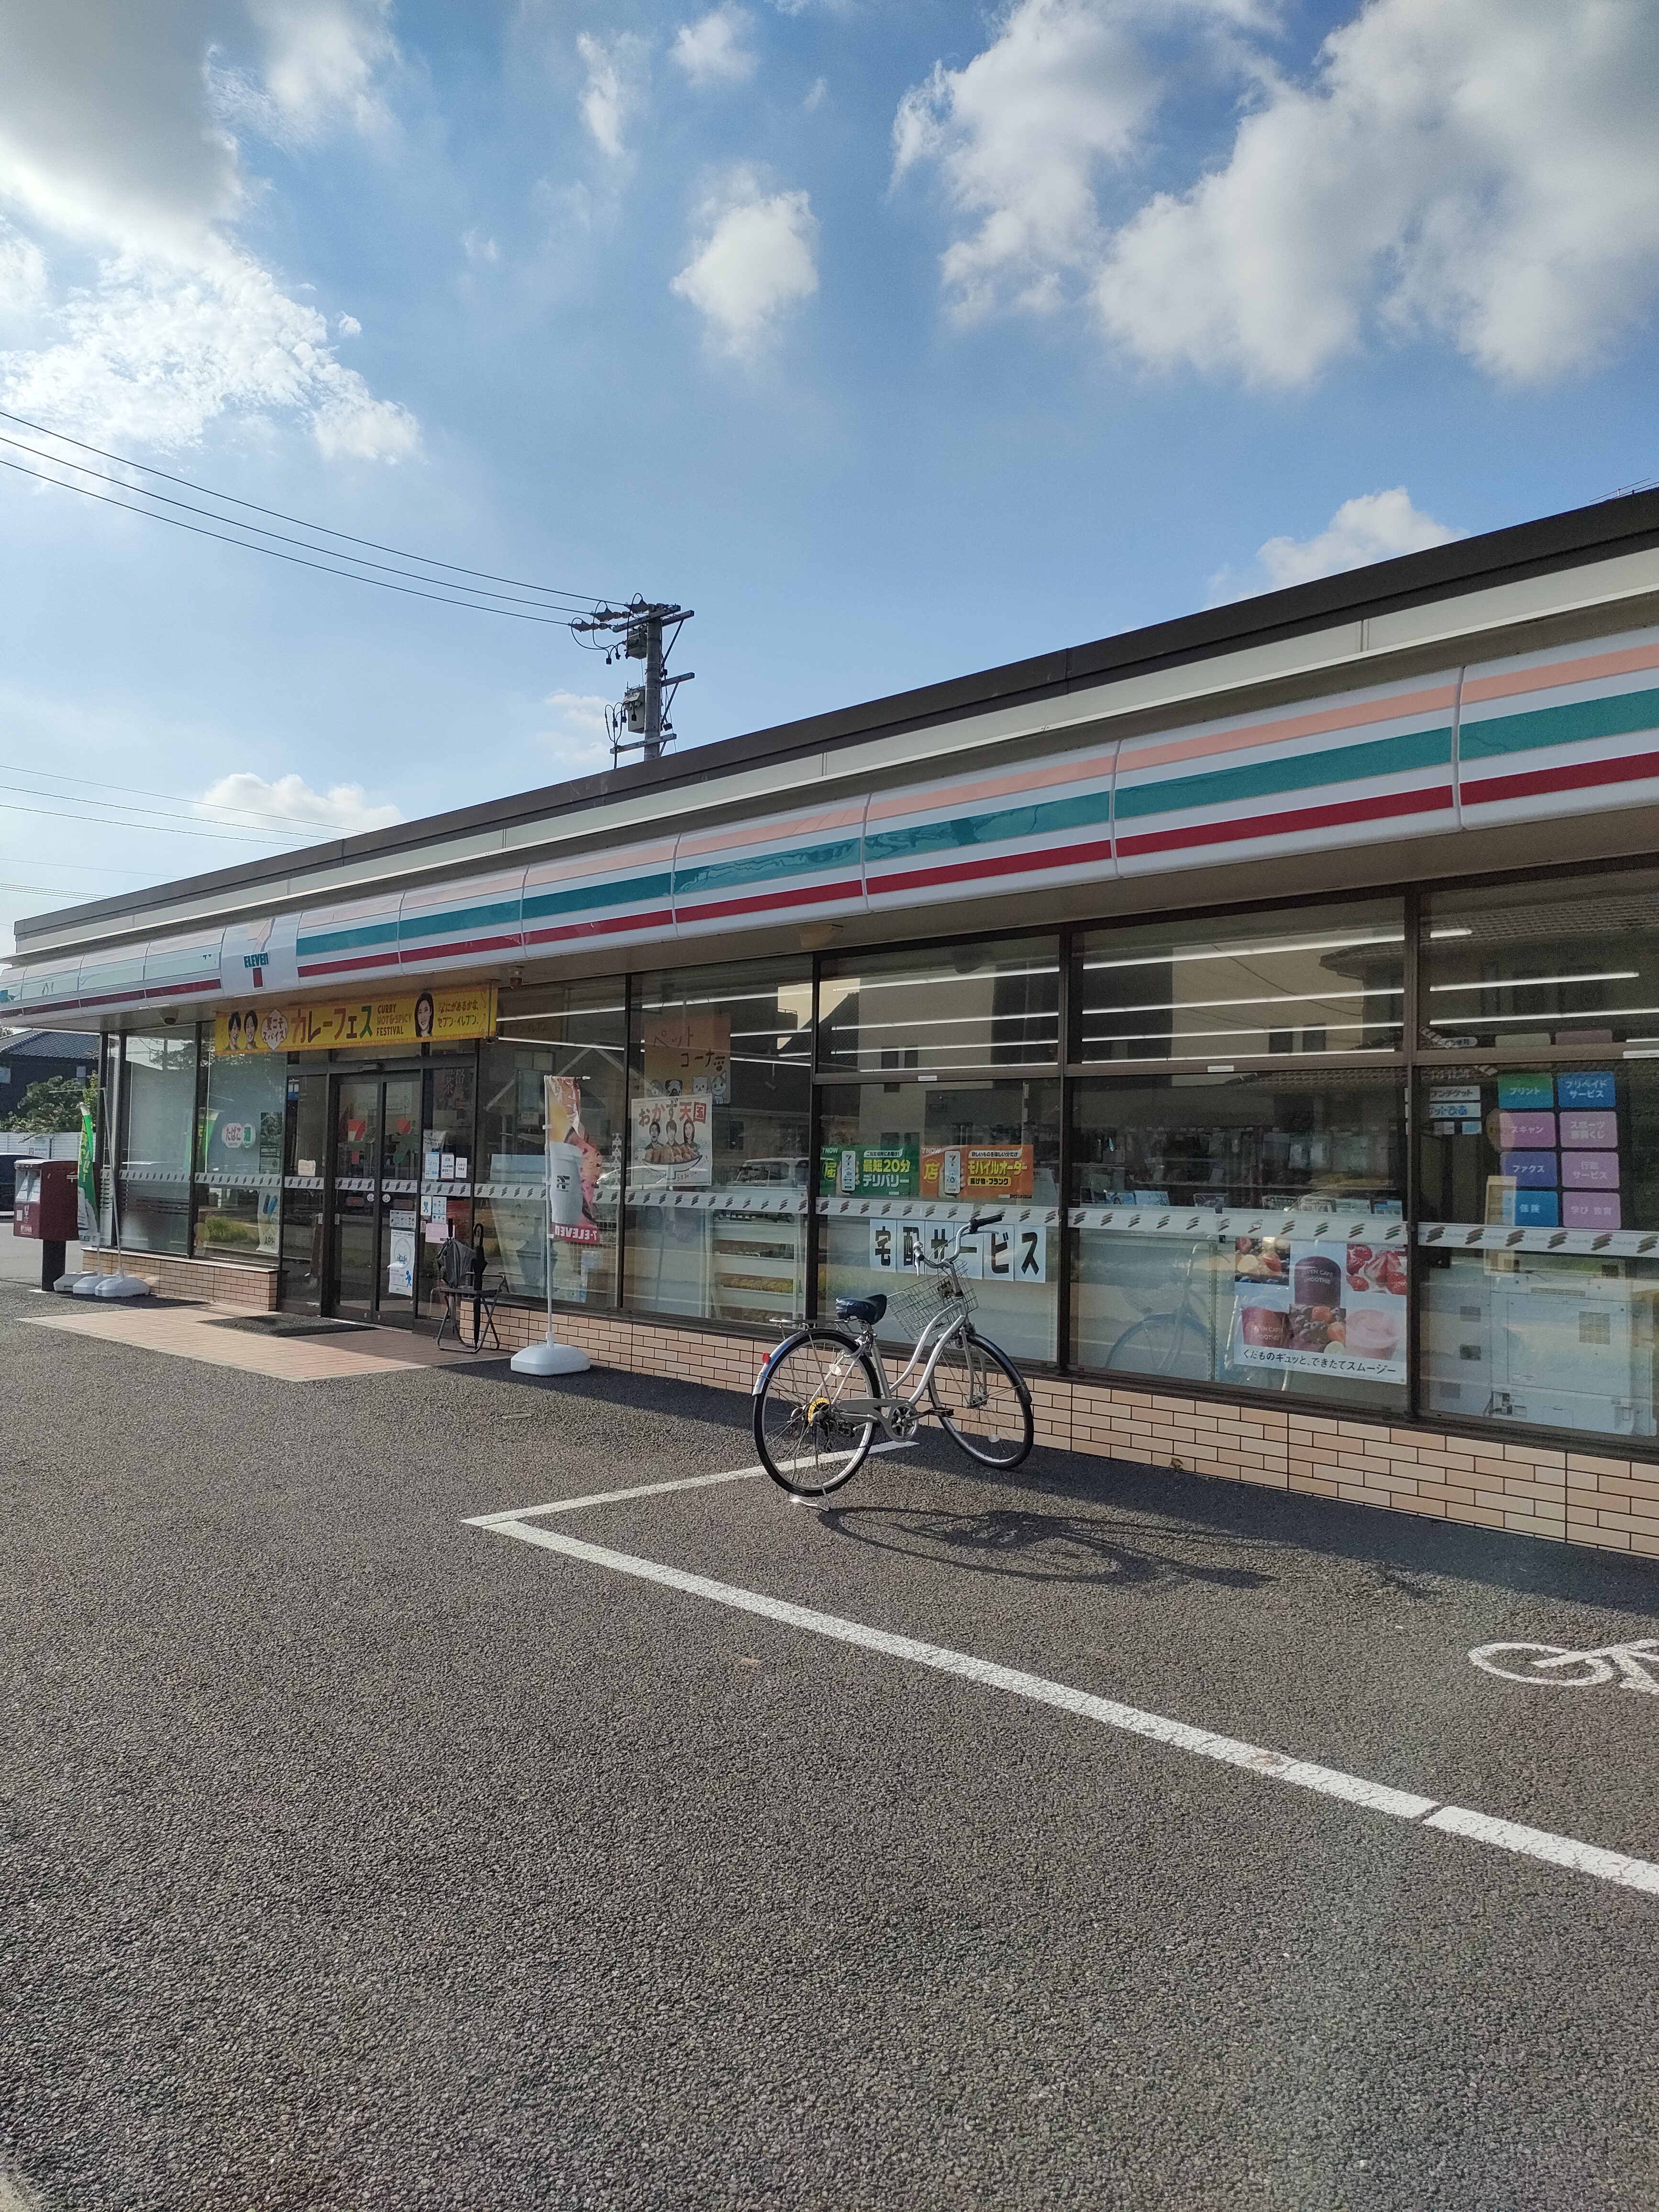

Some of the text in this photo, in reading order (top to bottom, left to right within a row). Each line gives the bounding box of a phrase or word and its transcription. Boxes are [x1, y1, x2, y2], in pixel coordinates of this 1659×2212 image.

[243, 952, 269, 968] ELEVEN
[378, 1004, 396, 1014] CURRY
[437, 1001, 479, 1014] なにがあるかな、
[267, 1017, 284, 1031] 夏こそ
[291, 1005, 373, 1044] カレーフェス
[377, 1013, 412, 1025] HOT&SPICY
[376, 1026, 404, 1036] FESTIVAL
[653, 1025, 694, 1048] ペット
[681, 1049, 726, 1068] コーナー
[1509, 1086, 1541, 1095] プリント
[1570, 1089, 1604, 1098] サービス
[639, 1097, 707, 1128] おかず天国
[226, 1127, 241, 1141] たばこ
[863, 1159, 910, 1172] 最短20分
[923, 1163, 940, 1180] 店
[967, 1160, 1028, 1175] モバイルオーダー
[863, 1173, 909, 1187] デリバリー
[874, 1226, 1040, 1275] 宅配サービス
[1243, 1349, 1396, 1374] くだものギュッと、できたてスムージー
